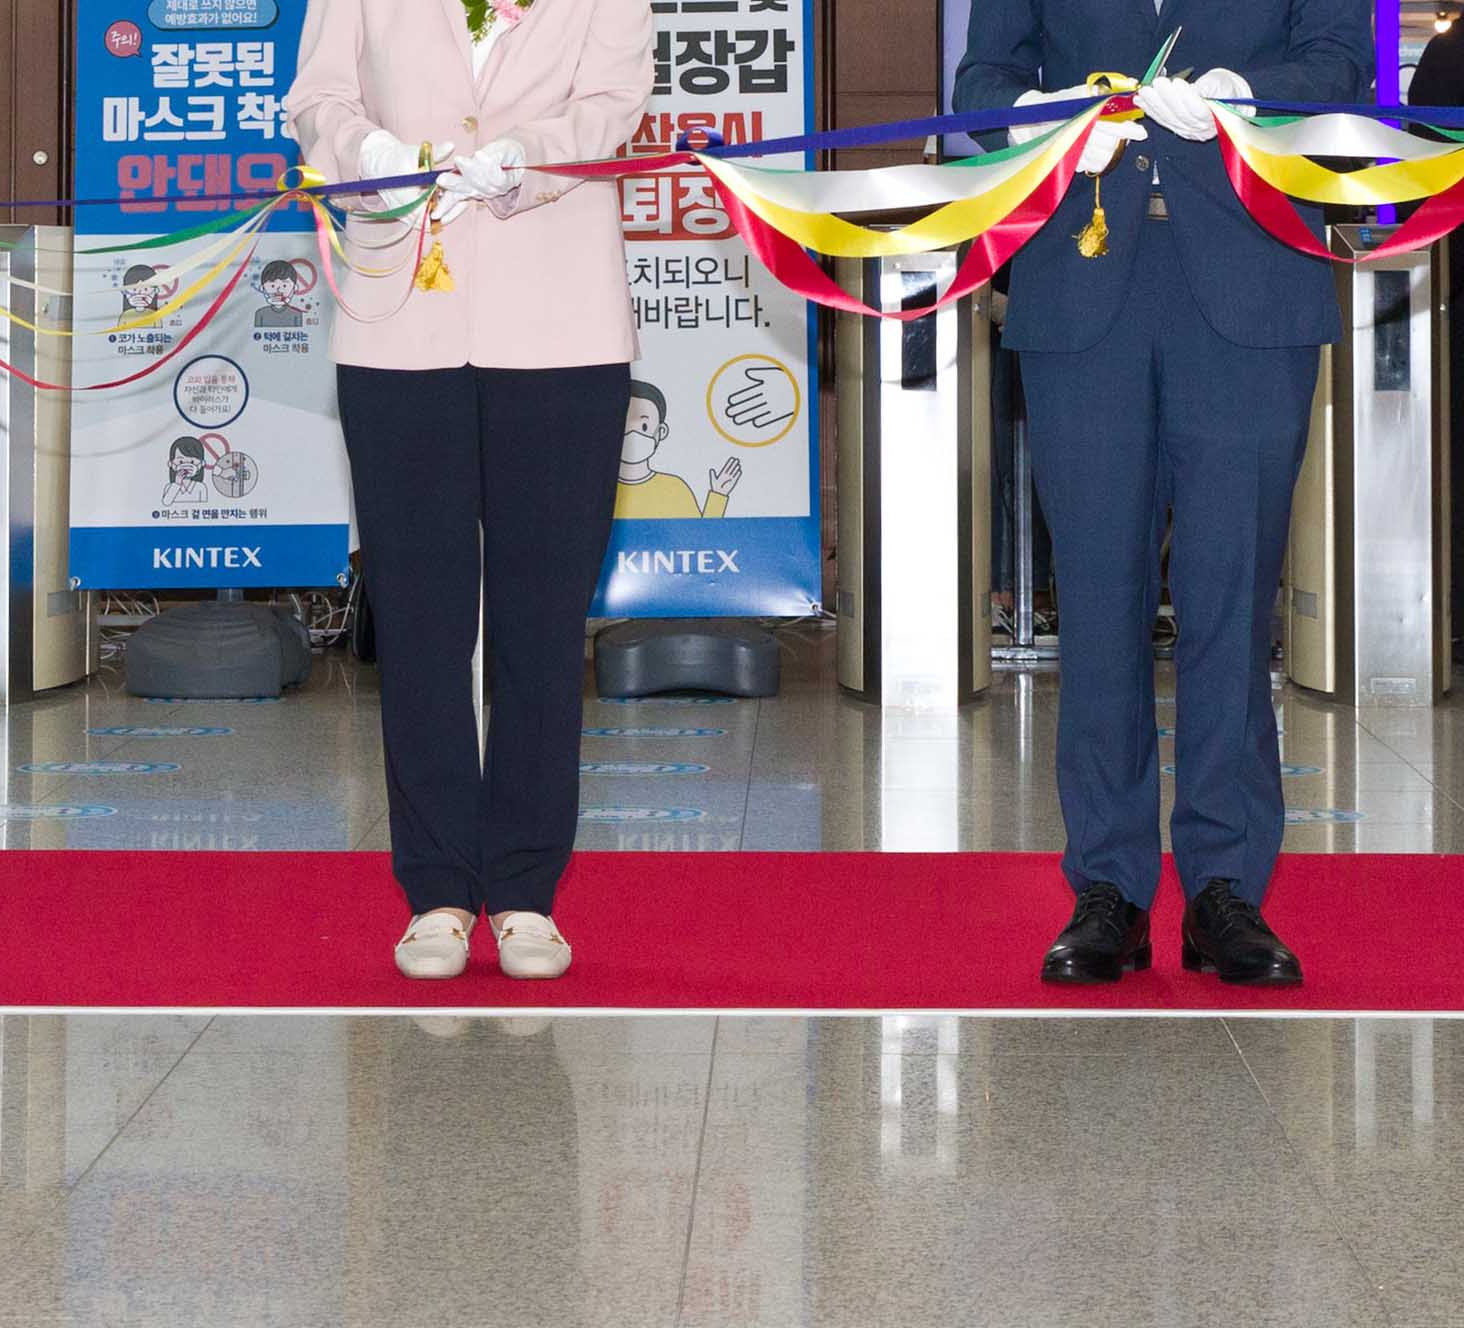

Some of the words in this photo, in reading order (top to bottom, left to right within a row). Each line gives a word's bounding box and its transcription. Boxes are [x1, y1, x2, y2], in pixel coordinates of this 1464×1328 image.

[111, 30, 138, 49] 주의!
[151, 42, 274, 88] 잘못된
[102, 96, 227, 142] 마스크
[237, 92, 297, 140] 착
[616, 112, 763, 158] 착용시
[626, 254, 749, 289] 치되오니
[161, 509, 189, 520] 마스크
[153, 547, 262, 569] KINTEX
[618, 550, 740, 574] KINTEX
